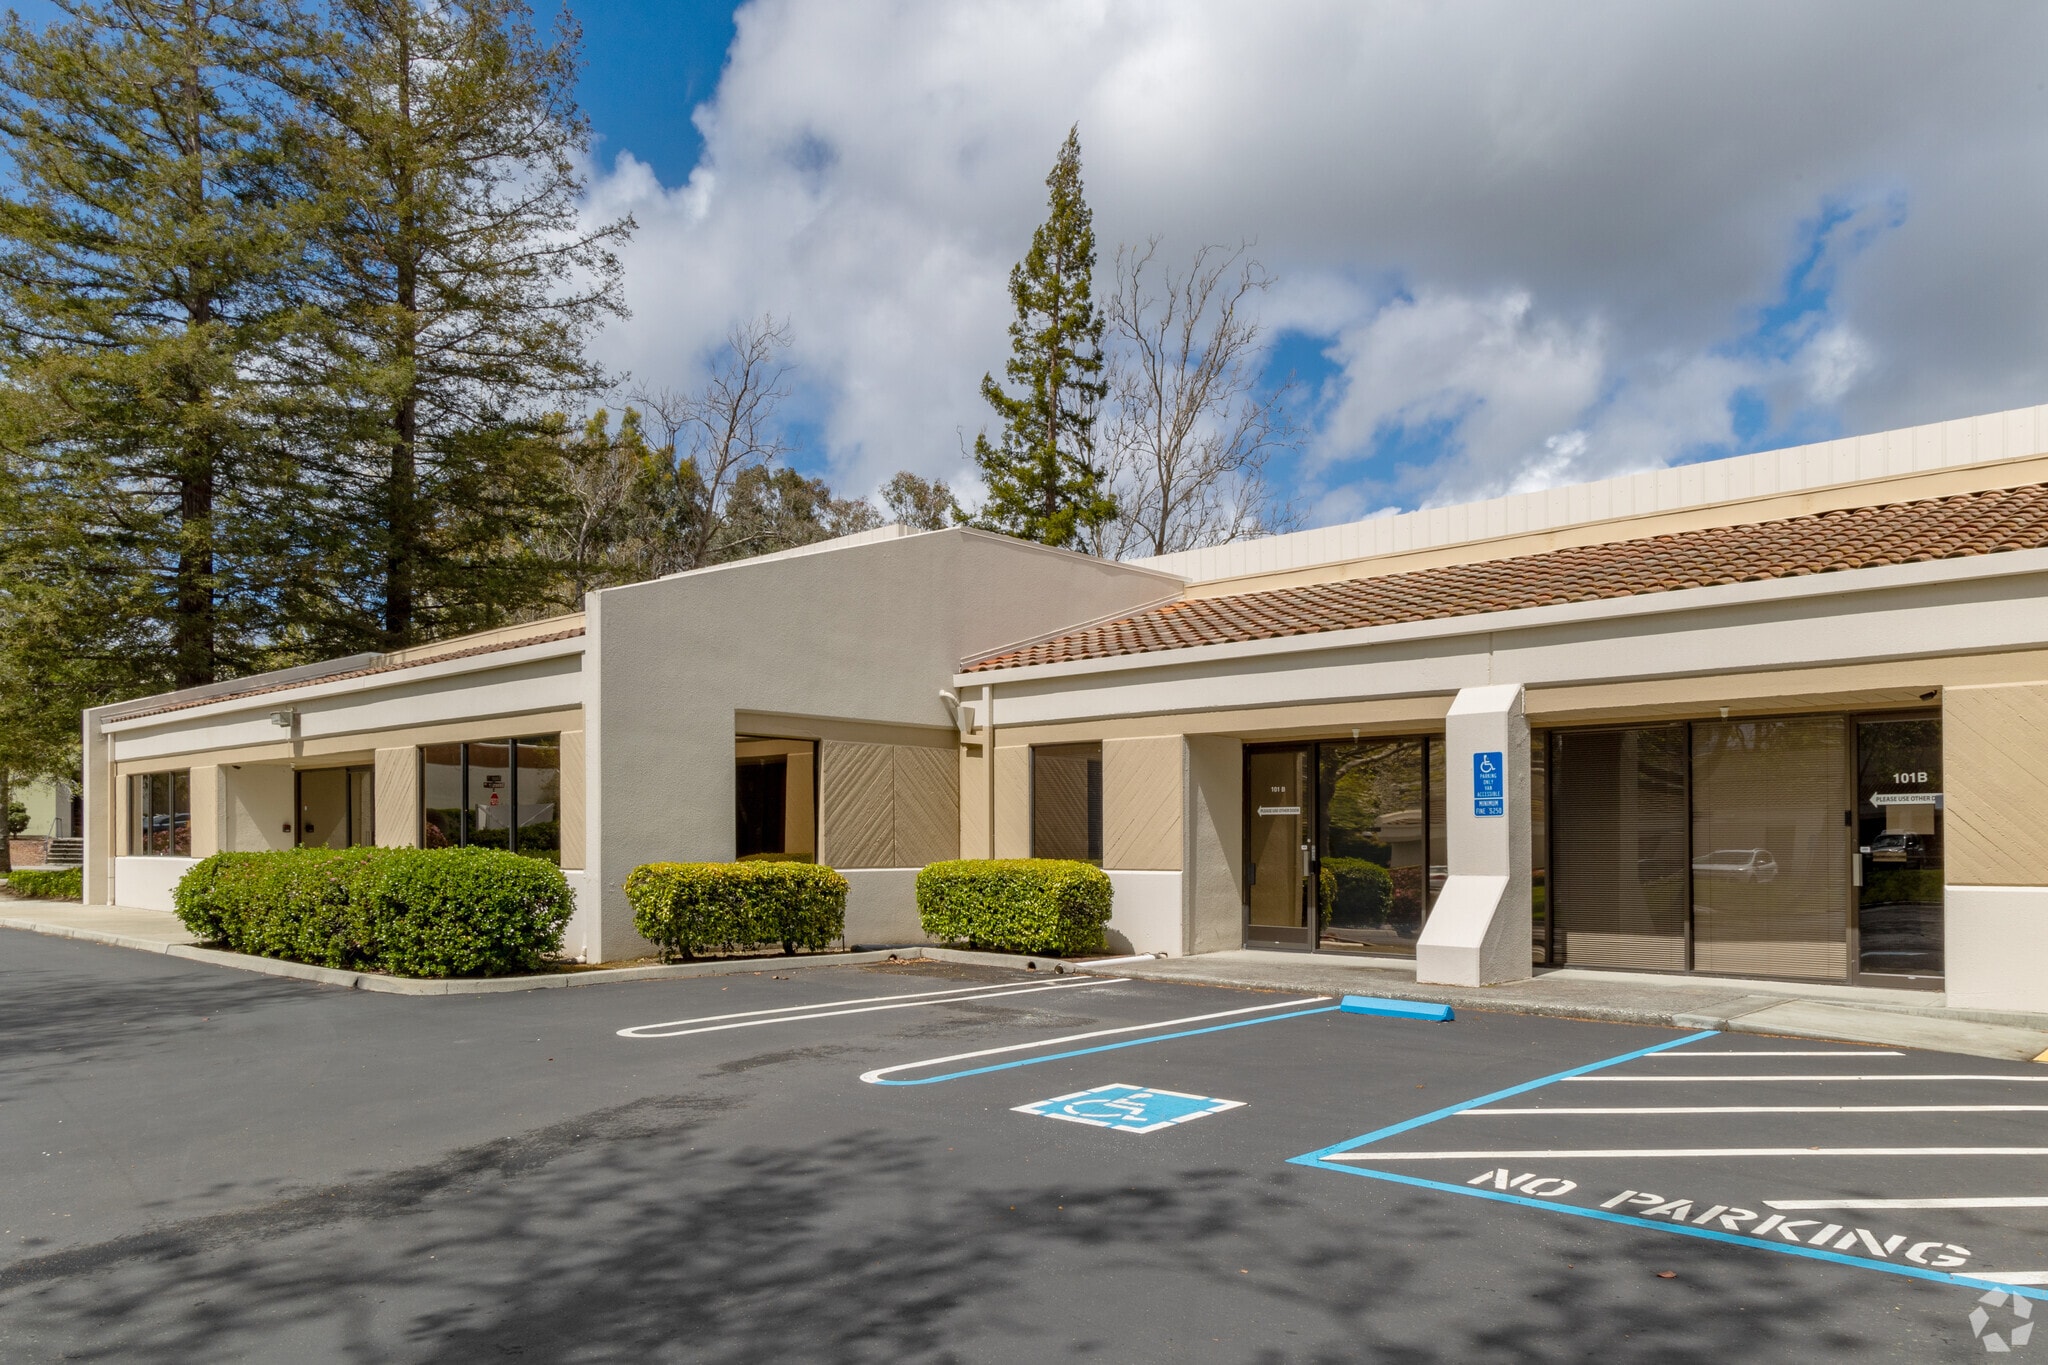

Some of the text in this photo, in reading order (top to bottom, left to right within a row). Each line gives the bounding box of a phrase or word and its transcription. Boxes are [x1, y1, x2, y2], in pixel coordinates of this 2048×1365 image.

[1893, 772, 1928, 784] 101B
[1467, 1168, 1971, 1267] NO PARKING
